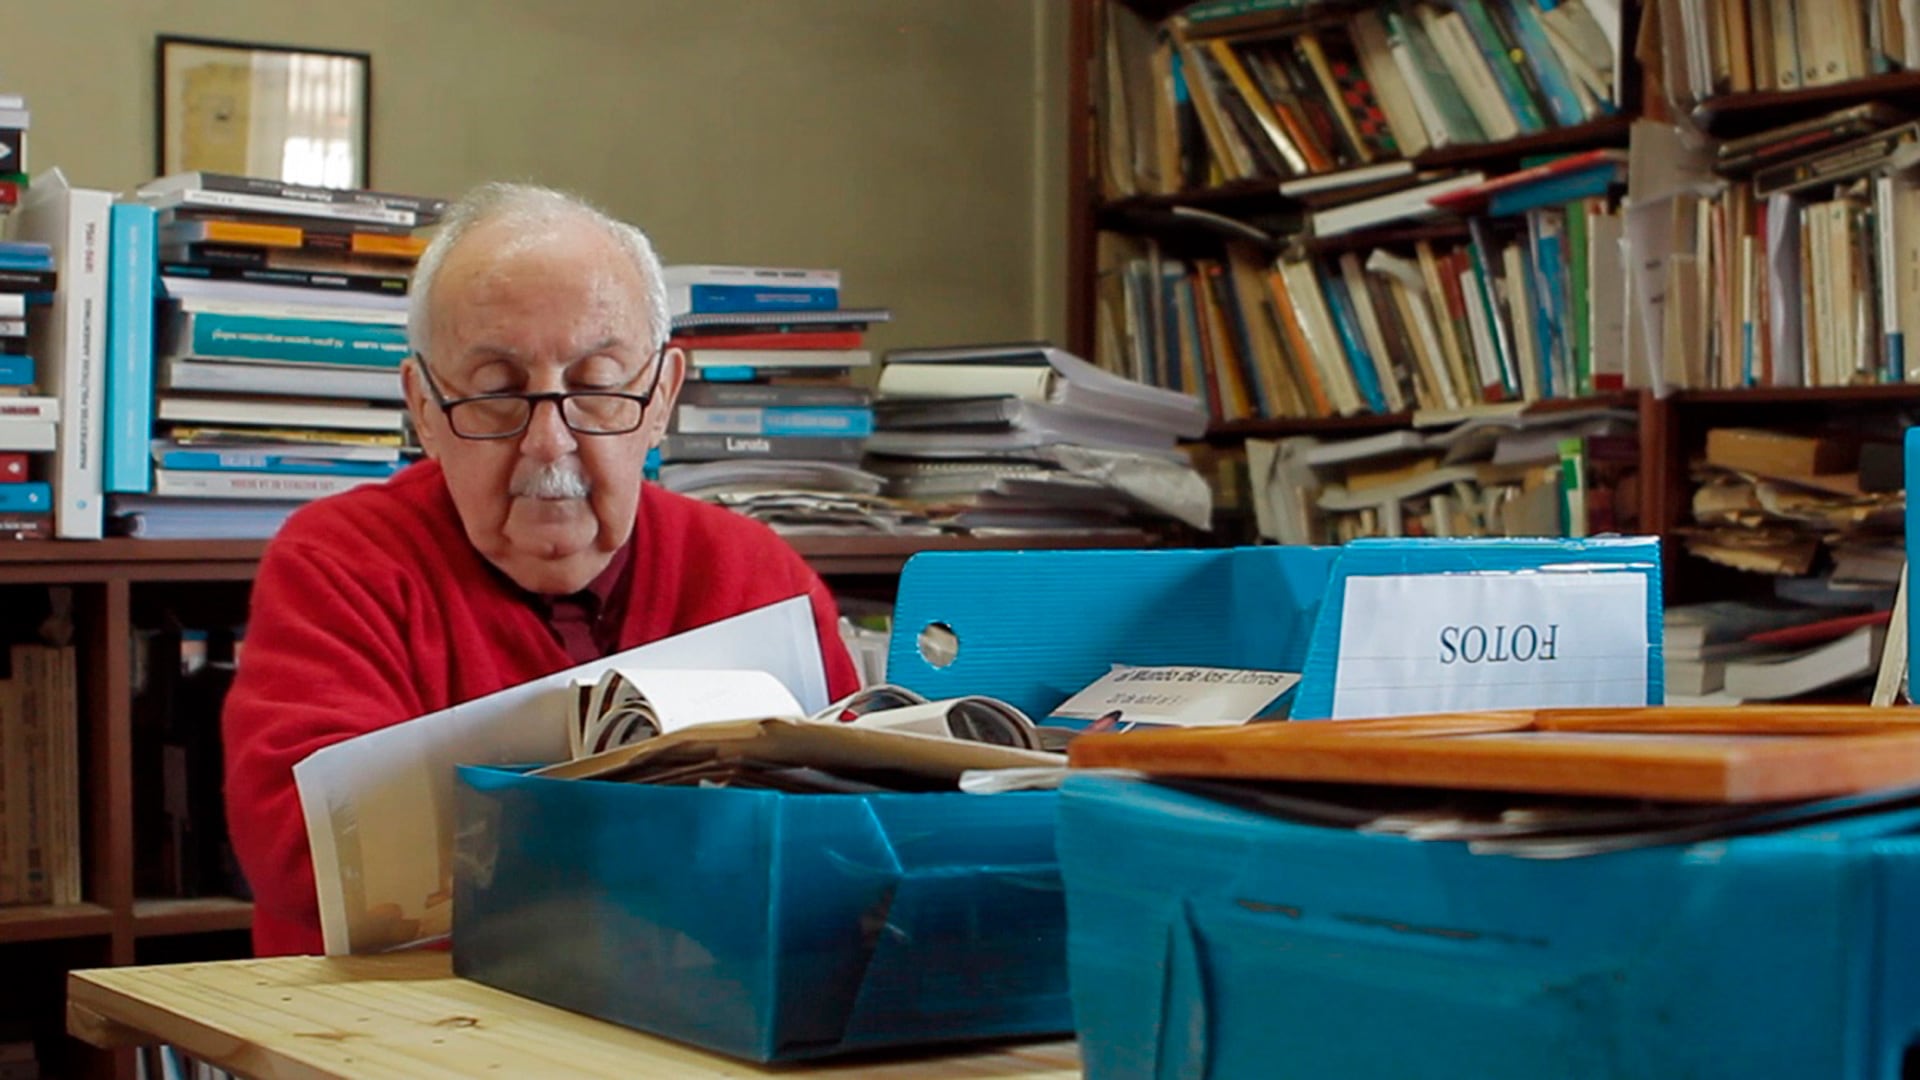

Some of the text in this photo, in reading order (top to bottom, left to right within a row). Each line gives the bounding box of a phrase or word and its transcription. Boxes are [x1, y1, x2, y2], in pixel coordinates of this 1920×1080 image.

[84, 298, 92, 356] ARGENTINOS
[80, 359, 90, 406] POLÍTICOS
[80, 409, 89, 470] MANIFIESTOS
[726, 436, 770, 452] Lanata
[1440, 624, 1558, 664] FOTOS
[1130, 669, 1179, 682] Mundo
[1178, 670, 1201, 683] de
[1201, 671, 1225, 684] los
[1226, 671, 1283, 686] Libros
